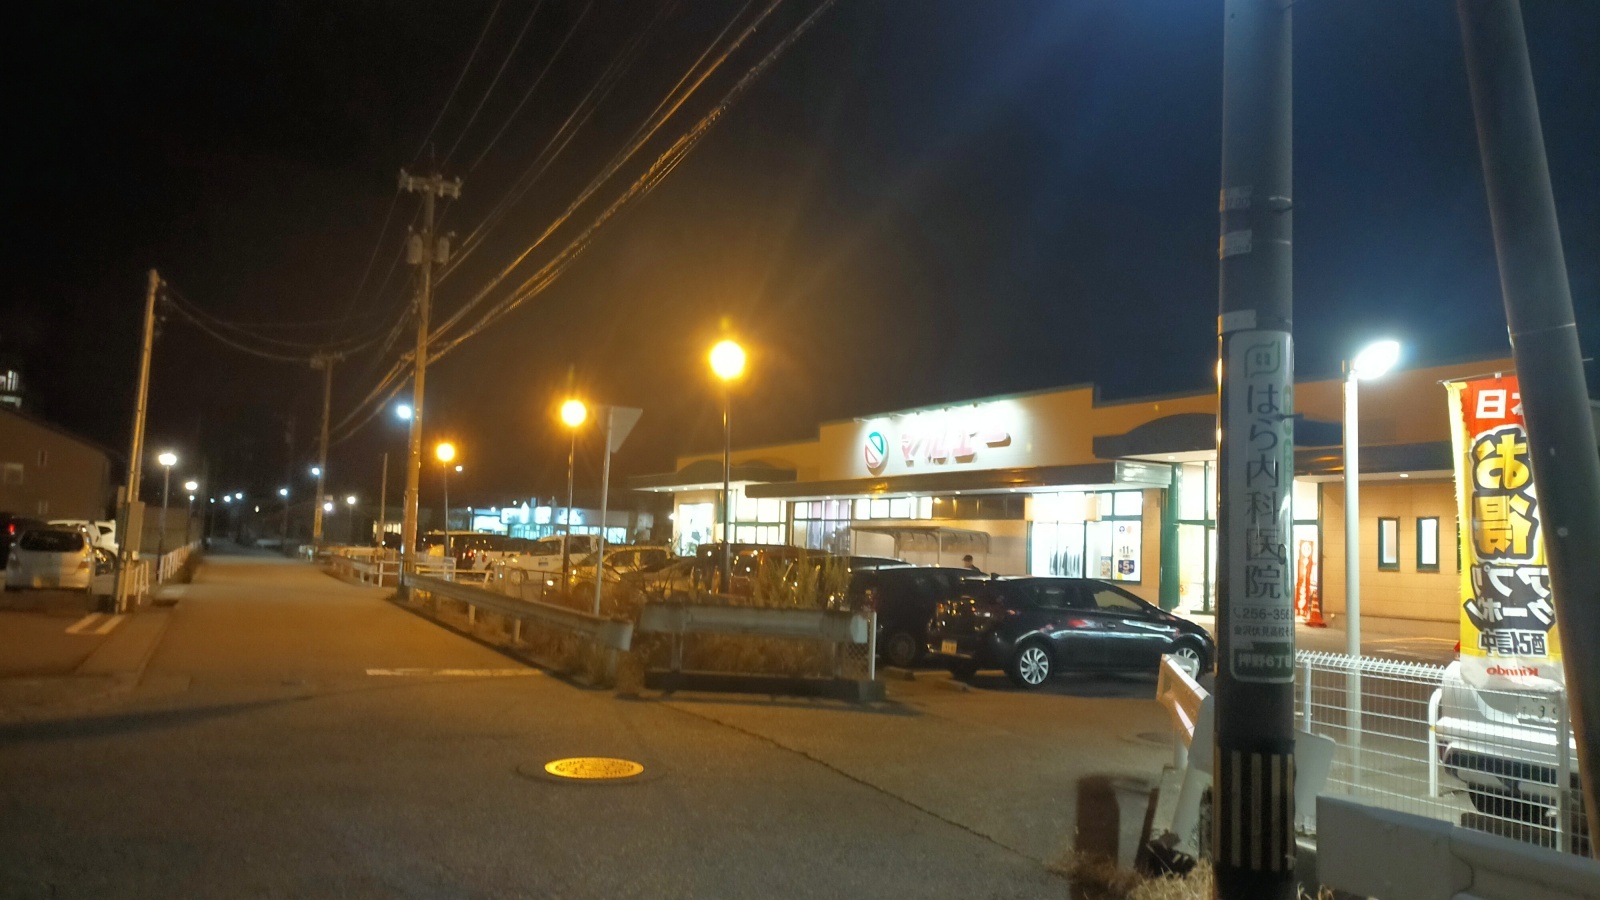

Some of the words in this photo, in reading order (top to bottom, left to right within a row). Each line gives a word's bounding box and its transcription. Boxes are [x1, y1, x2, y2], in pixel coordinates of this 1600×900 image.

[1245, 383, 1282, 600] はら内科医院
